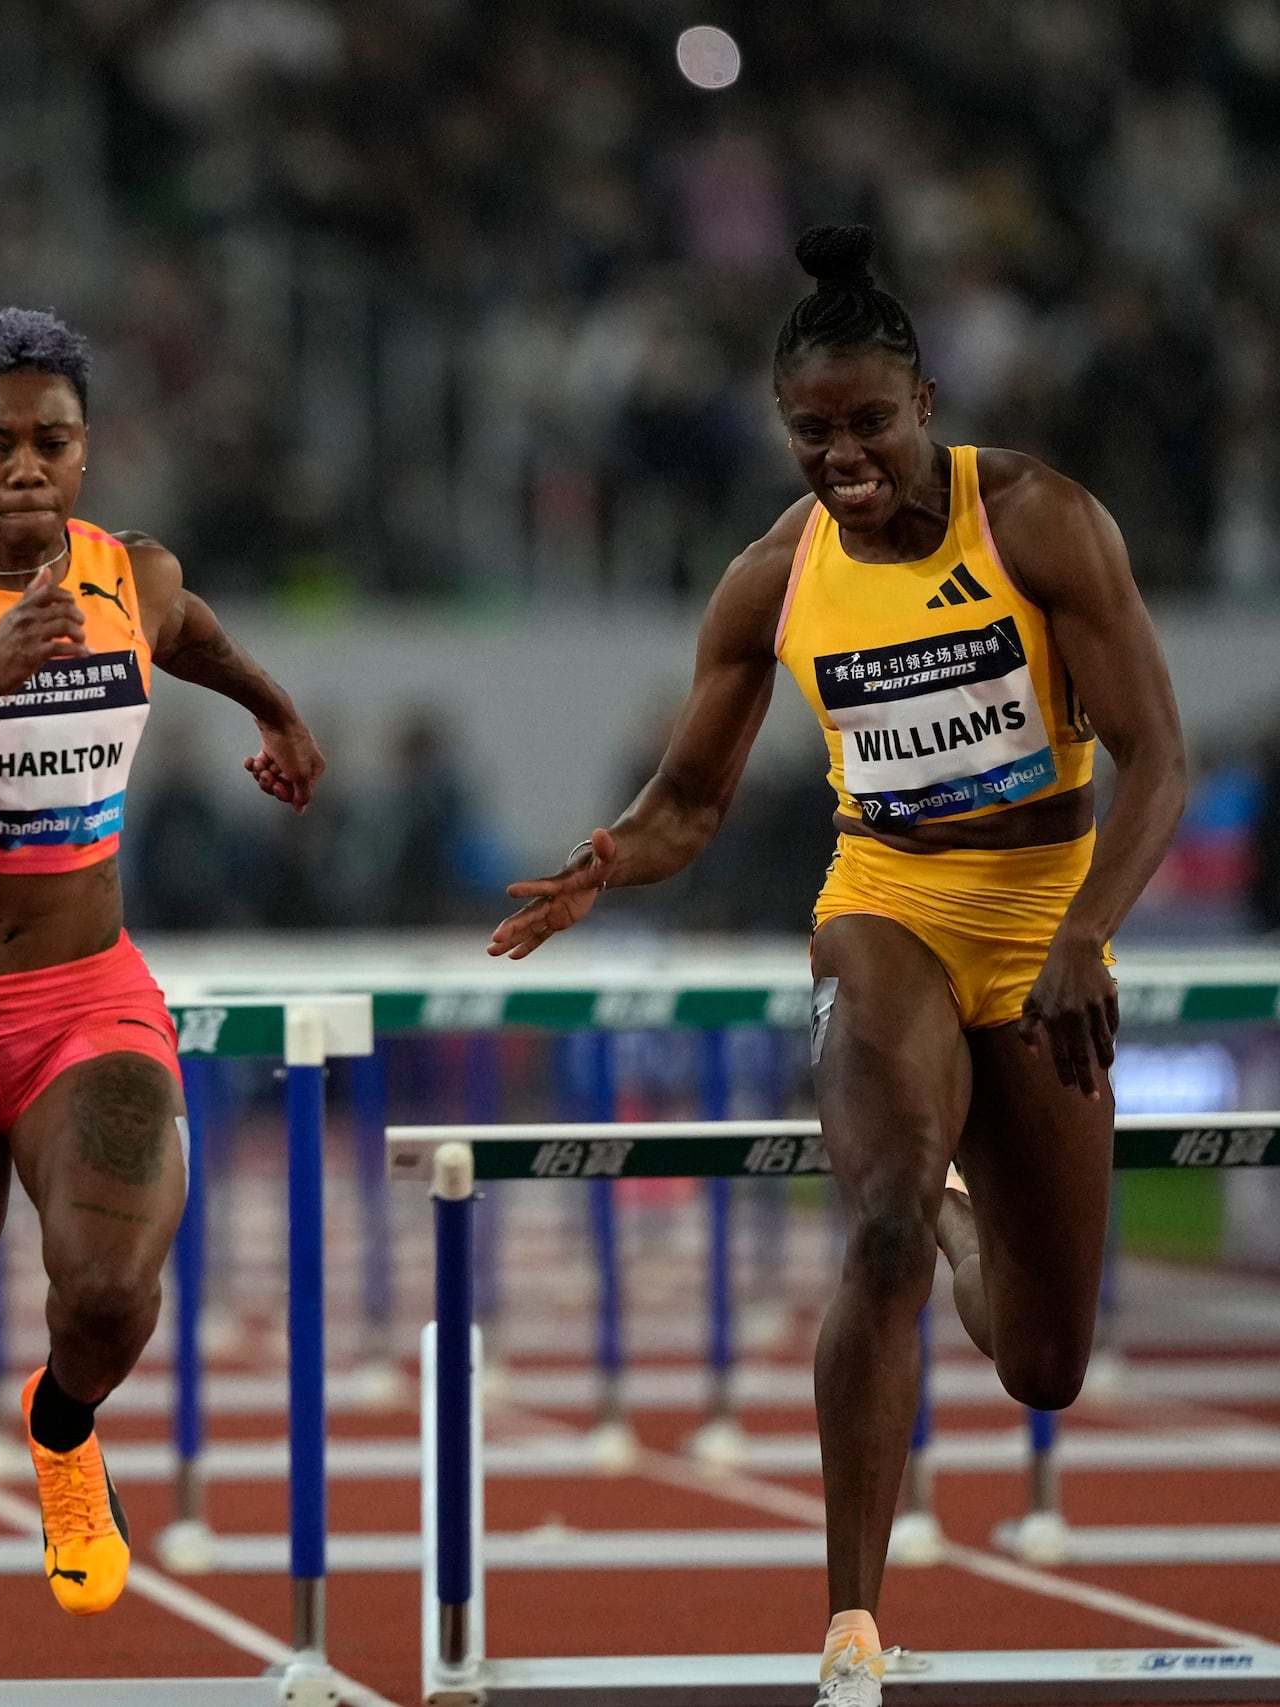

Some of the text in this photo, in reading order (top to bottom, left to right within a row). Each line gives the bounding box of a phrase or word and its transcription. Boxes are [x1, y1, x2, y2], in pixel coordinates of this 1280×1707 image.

[863, 661, 977, 693] SPORTSBEAMS
[853, 700, 1027, 762] WILLIAMS
[889, 785, 970, 817] Shanghai
[981, 762, 1046, 795] Suzhou
